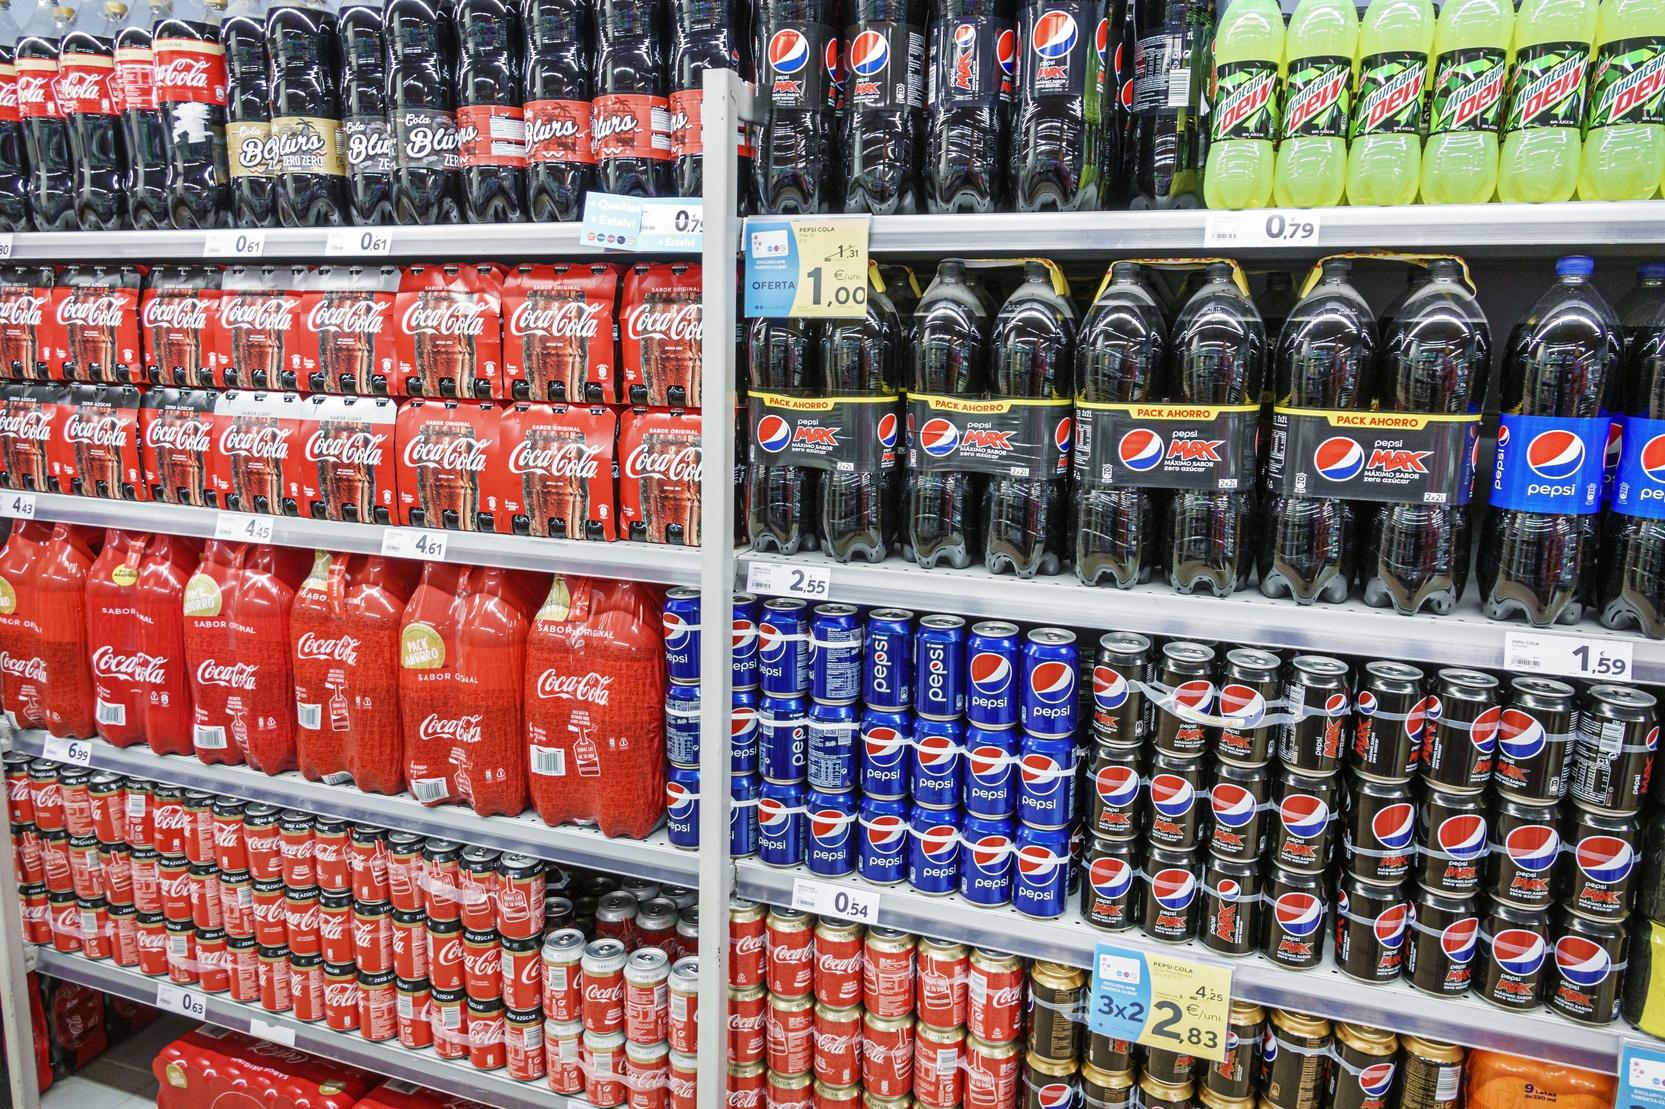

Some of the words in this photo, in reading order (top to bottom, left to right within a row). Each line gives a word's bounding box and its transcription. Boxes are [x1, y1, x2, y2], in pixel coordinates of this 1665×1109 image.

[773, 80, 801, 92] MAX
[854, 82, 882, 95] MAX
[1517, 57, 1577, 108] Mountain
[1217, 74, 1264, 118] Mountain
[1287, 69, 1335, 116] Mountain
[1363, 67, 1418, 117] Mountain
[405, 113, 431, 126] Cola
[1266, 214, 1314, 240] 0,79
[838, 245, 859, 259] 1,31
[752, 281, 795, 290] OFERTA
[807, 267, 866, 307] 1,00
[56, 296, 129, 326] Coca-Cola
[144, 298, 218, 329] Coca-Cola
[222, 298, 299, 331] Coca-Cola
[307, 299, 391, 334] Coca-Cola
[401, 297, 497, 336] Coca-Cola
[510, 300, 604, 338] Coca-Cola
[769, 397, 790, 407] PACK
[792, 399, 829, 410] AHORRO
[935, 400, 959, 409] PACK
[960, 402, 1004, 412] AHORRO
[1137, 409, 1165, 418] PACK
[1168, 409, 1211, 419] AHORRO
[797, 418, 819, 428] pepsi
[967, 421, 992, 430] pepsi
[1337, 416, 1366, 426] PACK
[1368, 416, 1418, 427] AHORRO
[64, 414, 132, 447] Coca-Cola
[146, 417, 221, 451] Coca-Cola
[792, 425, 841, 446] MAX
[1172, 429, 1198, 439] pepsi
[219, 425, 294, 459] Coca-Cola
[963, 429, 1017, 450] MAX
[1375, 438, 1403, 449] pepsi
[306, 431, 388, 466] Coca-Cola
[404, 433, 492, 472] Coca-Cola
[815, 444, 834, 452] SABOR
[986, 448, 1007, 456] SABOR
[1166, 439, 1226, 461] MAX
[508, 440, 605, 479] Coca-Cola
[1164, 459, 1191, 467] MÁXIMO
[1367, 449, 1435, 473] MAX
[1181, 465, 1206, 473] azúcar
[1364, 470, 1394, 479] MÁXIMO
[1395, 472, 1420, 480] SABOR
[1494, 448, 1505, 489] pepsi
[1364, 475, 1382, 483] zero
[1382, 477, 1410, 485] azúcar
[1424, 492, 1447, 502] 2x2L
[1527, 484, 1575, 498] pepsi
[790, 569, 825, 595] 2,55
[102, 607, 137, 615] SABOR
[194, 620, 226, 628] SABOR
[407, 637, 429, 652] PACK
[872, 635, 892, 693] pepsi
[1572, 645, 1626, 675] 1,59
[418, 673, 451, 681] SABOR
[927, 643, 948, 702] pepsi
[537, 668, 615, 706] Coca-Cola
[972, 696, 1008, 709] pepsi
[1033, 705, 1070, 719] pepsi
[1324, 718, 1343, 759] MAX
[867, 769, 900, 781] pepsi
[919, 778, 954, 791] pepsi
[1633, 774, 1641, 794] pepsi
[972, 788, 1007, 801] pepsi
[1022, 795, 1057, 811] pepsi
[758, 837, 786, 850] pepsi
[813, 849, 846, 862] pepsi
[869, 855, 903, 868] pepsi
[923, 865, 957, 878] pepsi
[975, 876, 1009, 890] pepsi
[1585, 882, 1607, 890] pepsi
[1018, 886, 1054, 901] pepsi
[834, 892, 868, 918] 0,54
[1217, 899, 1237, 943] MAX
[1153, 961, 1173, 970] PEPSI
[1174, 966, 1193, 974] COLA
[1501, 973, 1522, 982] pepsi
[1195, 986, 1223, 1001] 4,25
[1098, 995, 1144, 1023] 3x2
[1151, 1000, 1218, 1049] 2,83
[1525, 1084, 1534, 1093] 9
